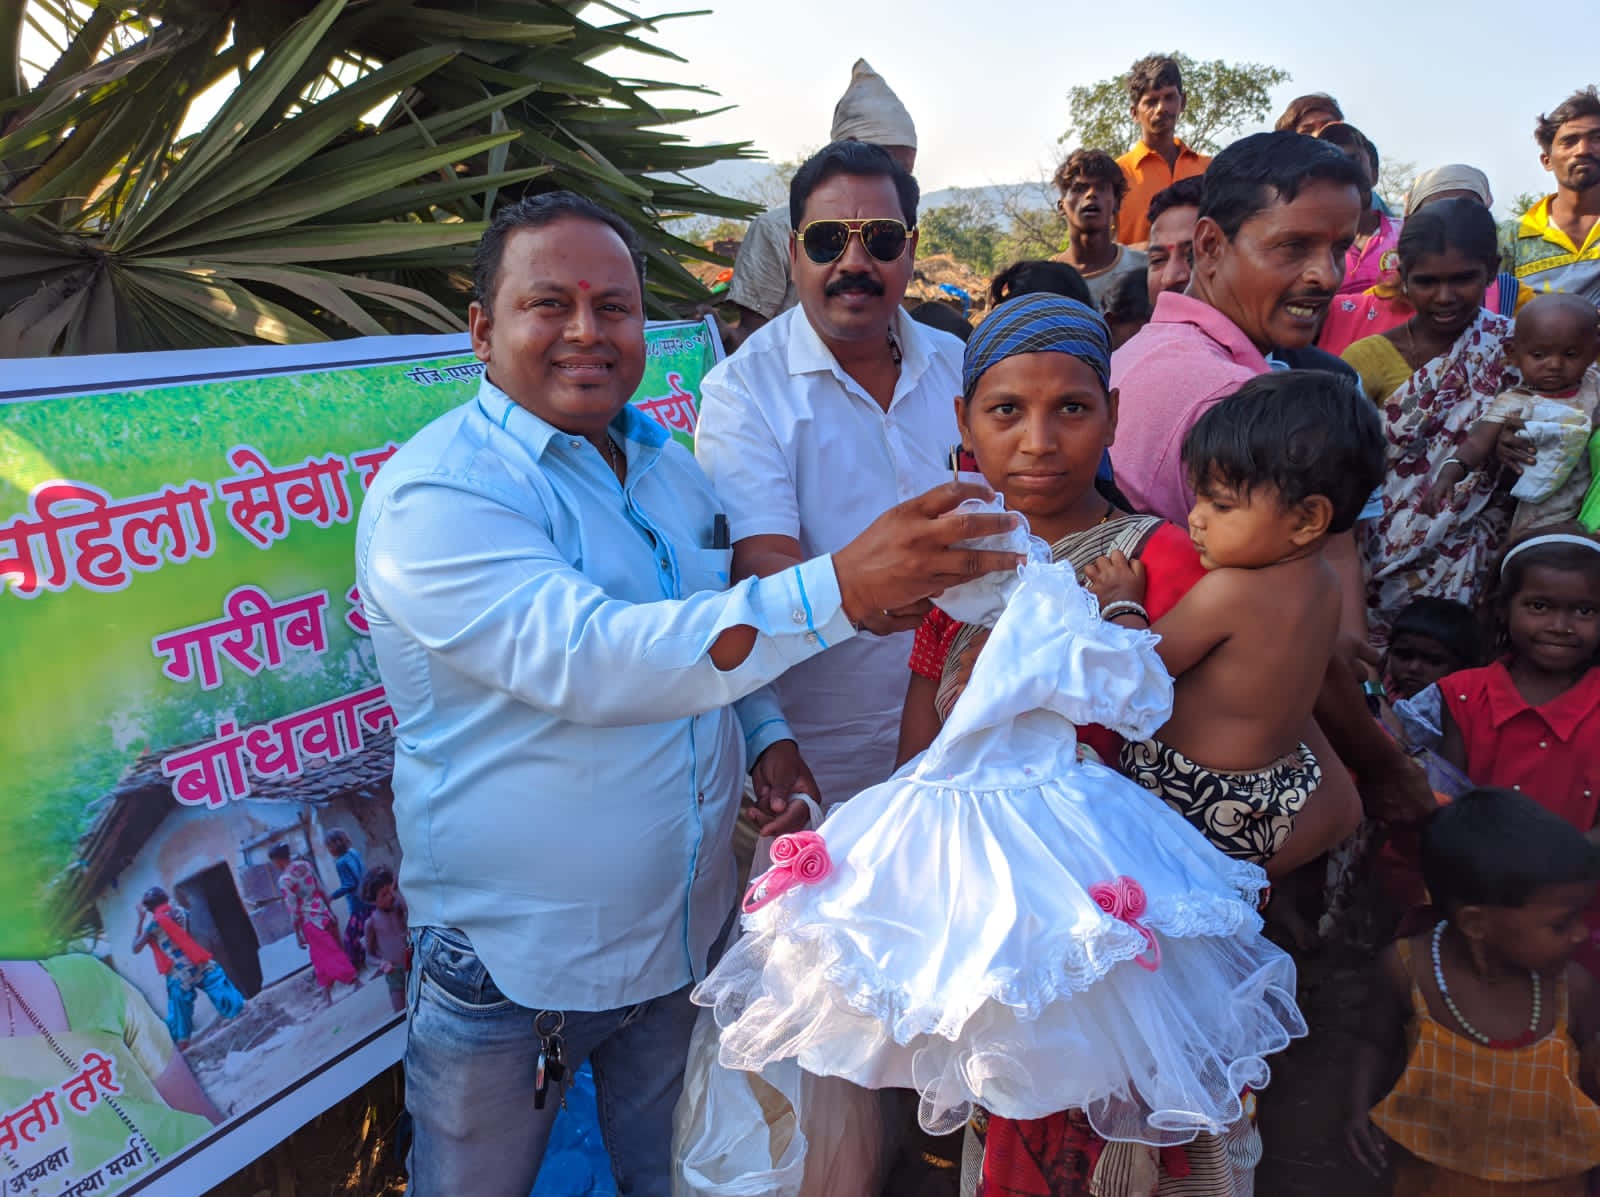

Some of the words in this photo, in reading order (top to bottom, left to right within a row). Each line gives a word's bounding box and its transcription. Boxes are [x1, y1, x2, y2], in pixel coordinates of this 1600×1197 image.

[222, 449, 345, 544] सेवा
[157, 589, 326, 686] गरीब
[62, 1053, 120, 1112] तरे
[105, 1137, 143, 1176] मर्या
